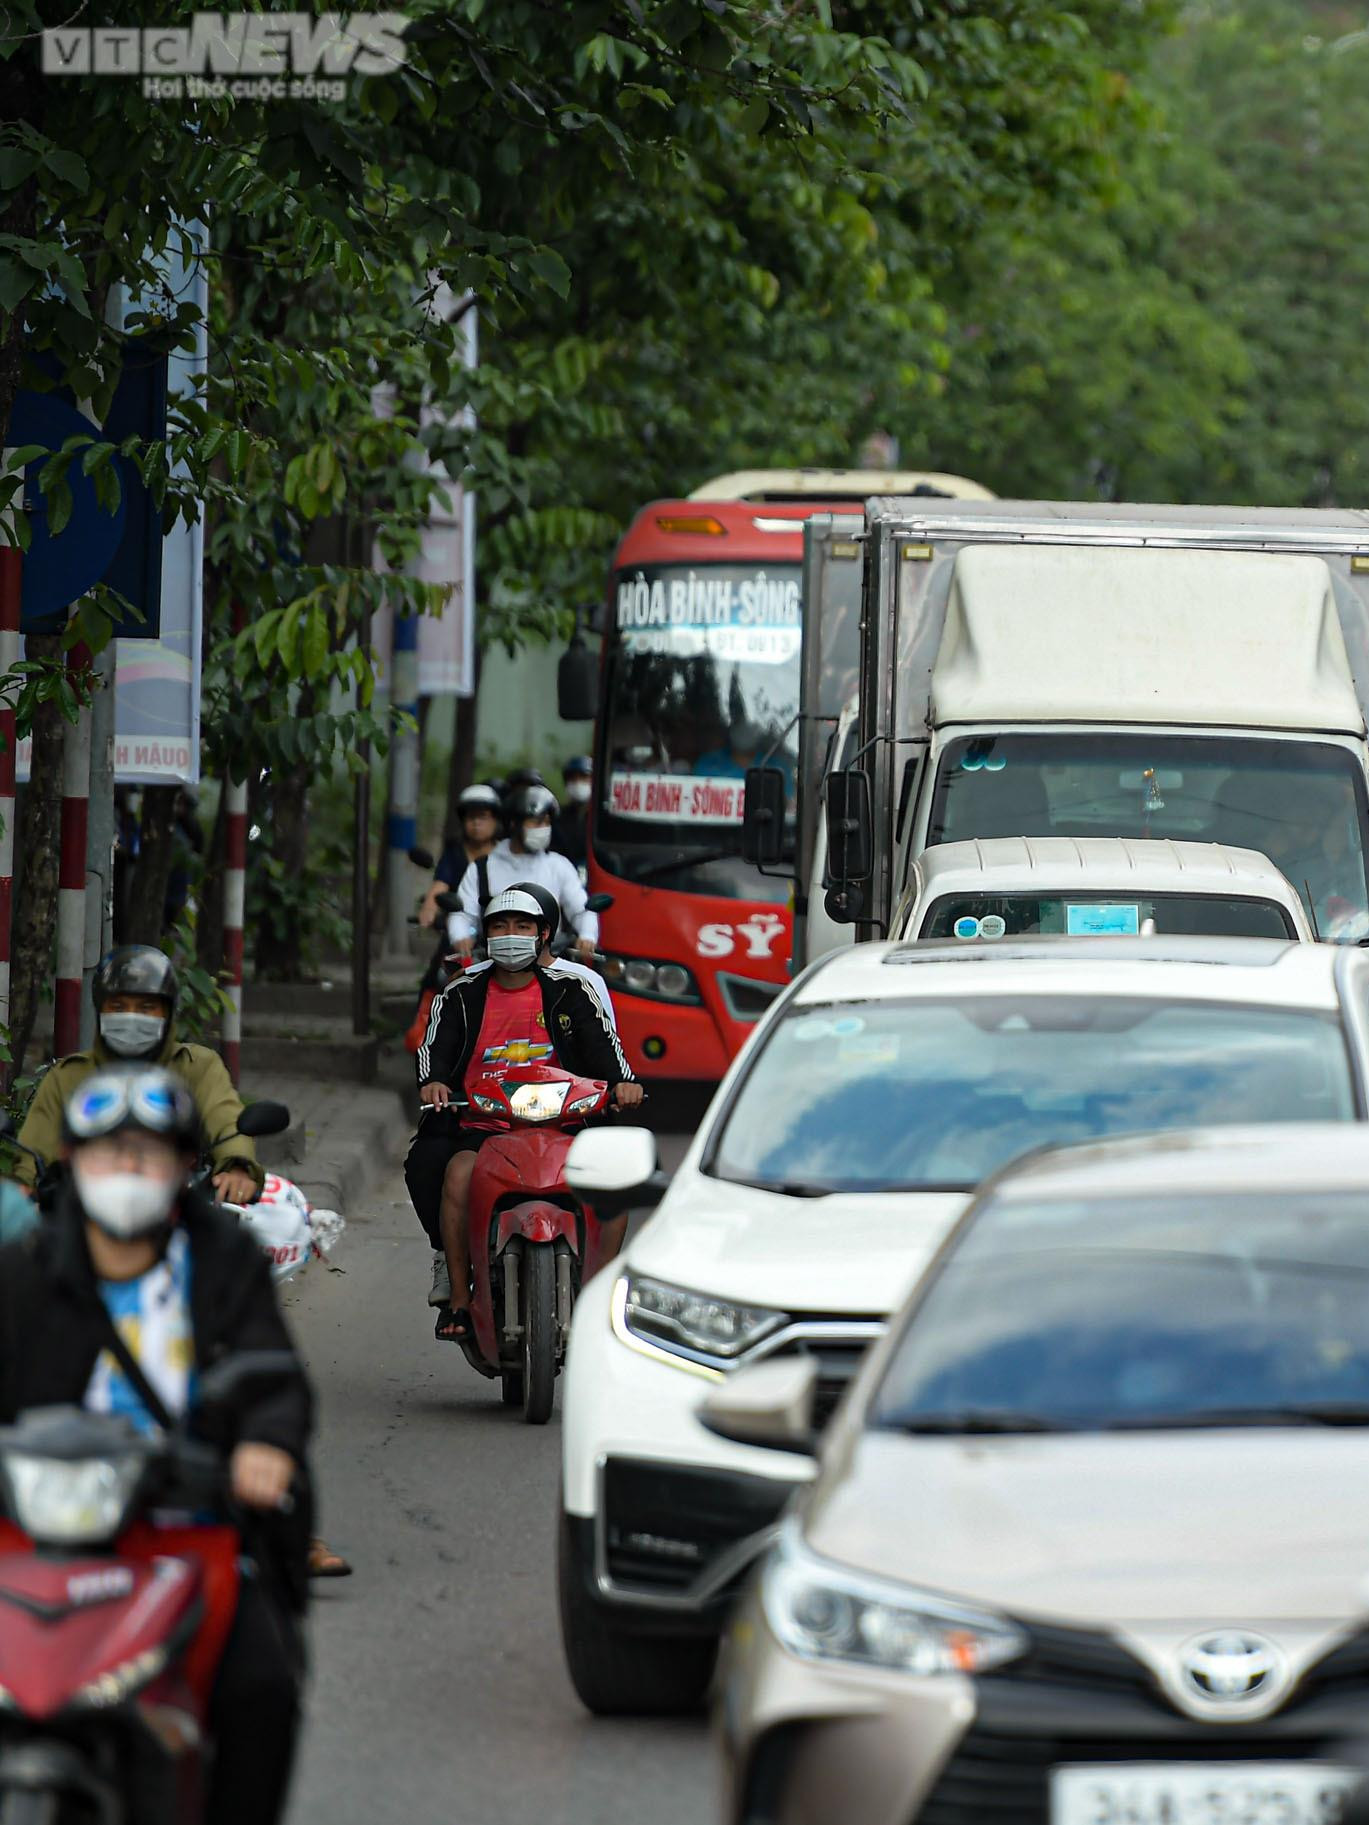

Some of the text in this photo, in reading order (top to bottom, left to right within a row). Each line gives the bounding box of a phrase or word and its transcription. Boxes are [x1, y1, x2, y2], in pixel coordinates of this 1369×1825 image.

[617, 571, 667, 627] HÒA
[613, 774, 641, 811] HÒA
[646, 775, 683, 813] BÌNH
[691, 777, 734, 817] SÔNG
[696, 913, 786, 959] SỸ
